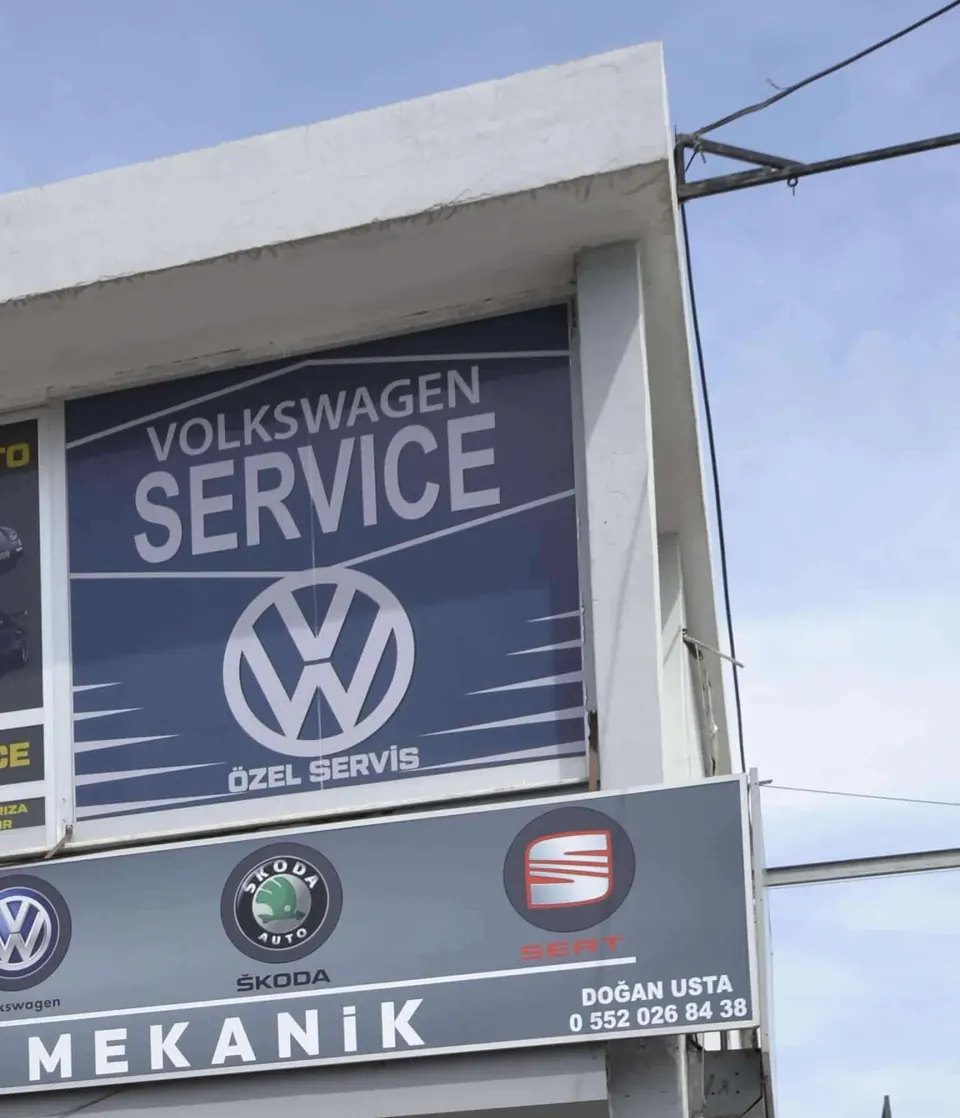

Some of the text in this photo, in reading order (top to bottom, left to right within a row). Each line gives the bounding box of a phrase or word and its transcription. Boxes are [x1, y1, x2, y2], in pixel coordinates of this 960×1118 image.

[147, 365, 481, 463] VOLKSWAGEN
[134, 412, 501, 564] SERVICE
[227, 745, 420, 794] ÖZEL SERVİS
[258, 927, 307, 945] AUTO
[519, 934, 624, 961] SEAT
[236, 969, 331, 992] ŠKODA
[581, 974, 733, 1007] DOĞAN USTA
[569, 998, 747, 1032] 0 552 026 84 38
